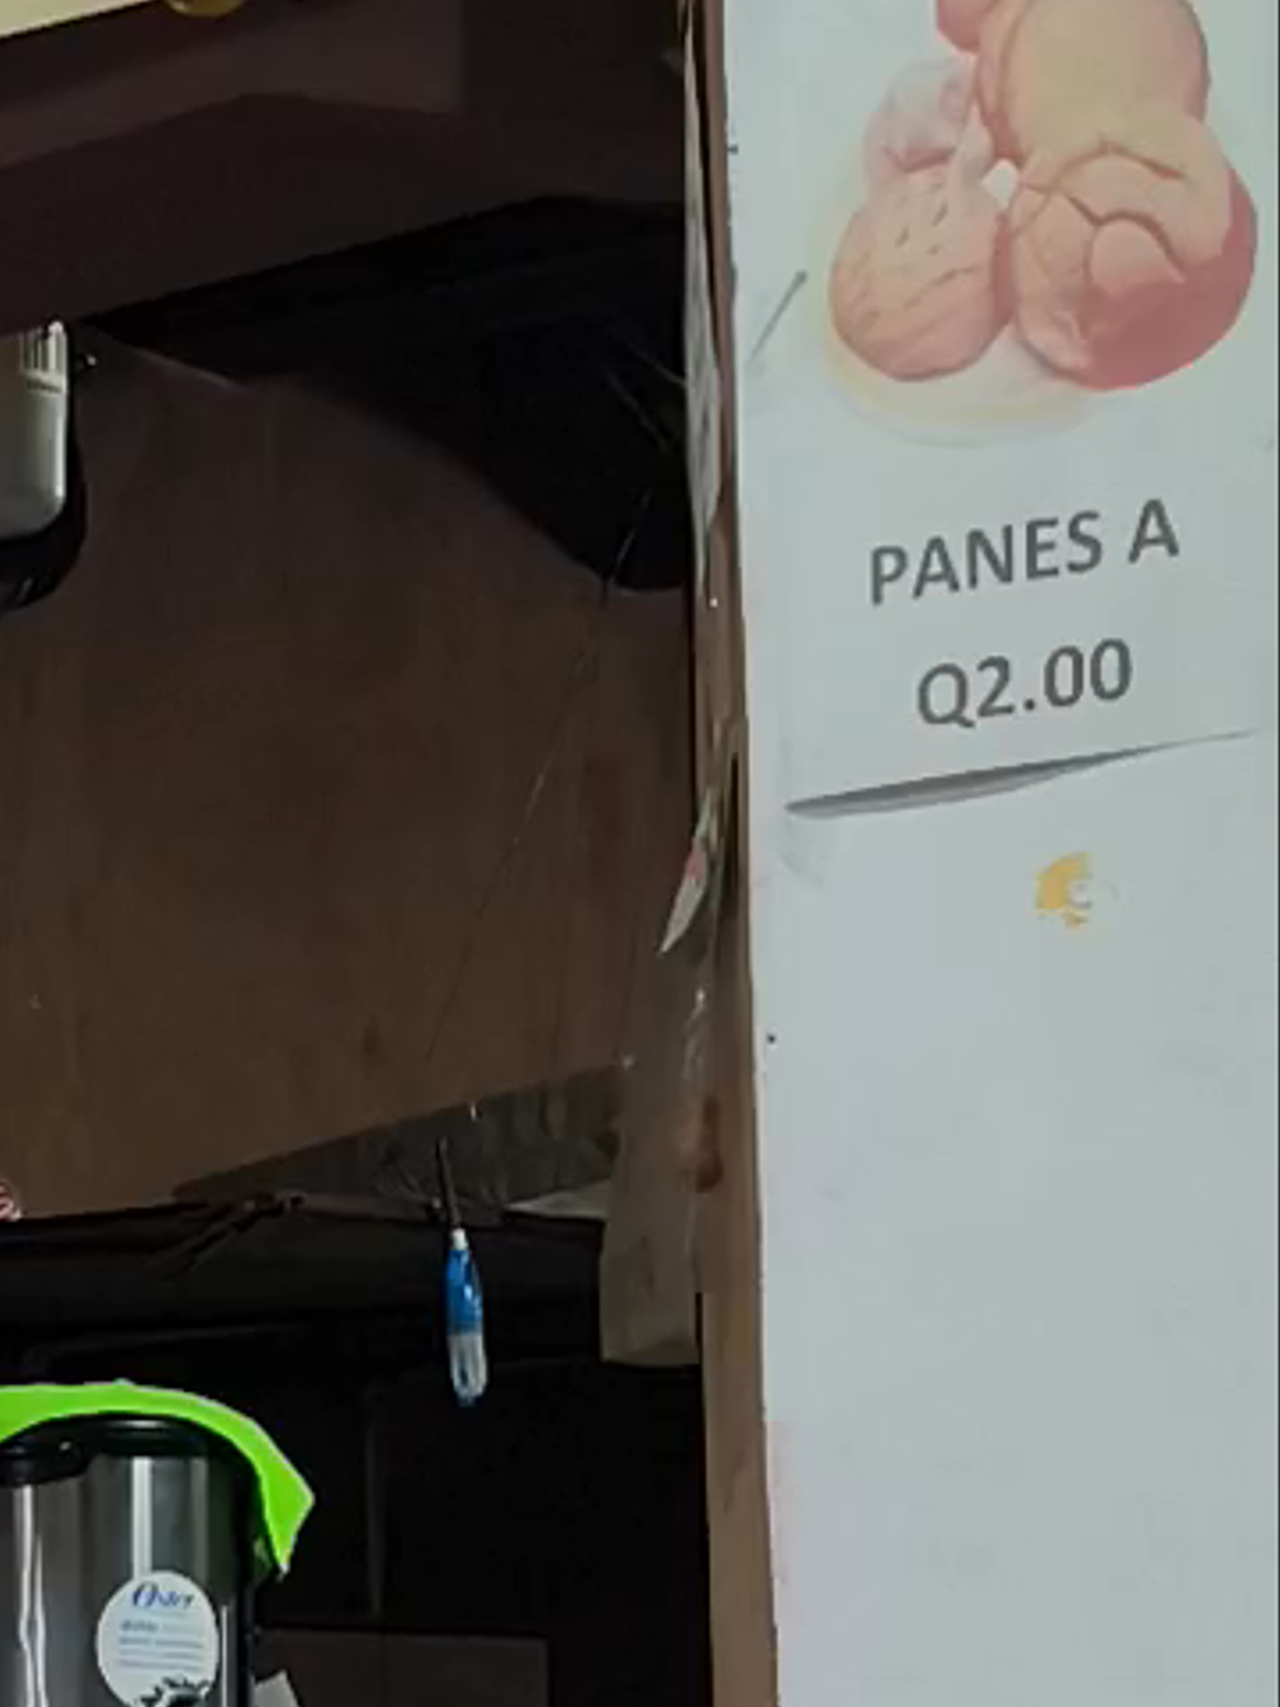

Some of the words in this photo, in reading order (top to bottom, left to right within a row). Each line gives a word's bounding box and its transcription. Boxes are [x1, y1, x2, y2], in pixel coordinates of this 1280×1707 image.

[869, 509, 1104, 607] PANES
[1126, 497, 1181, 565] A
[915, 637, 1134, 730] Q2.00
